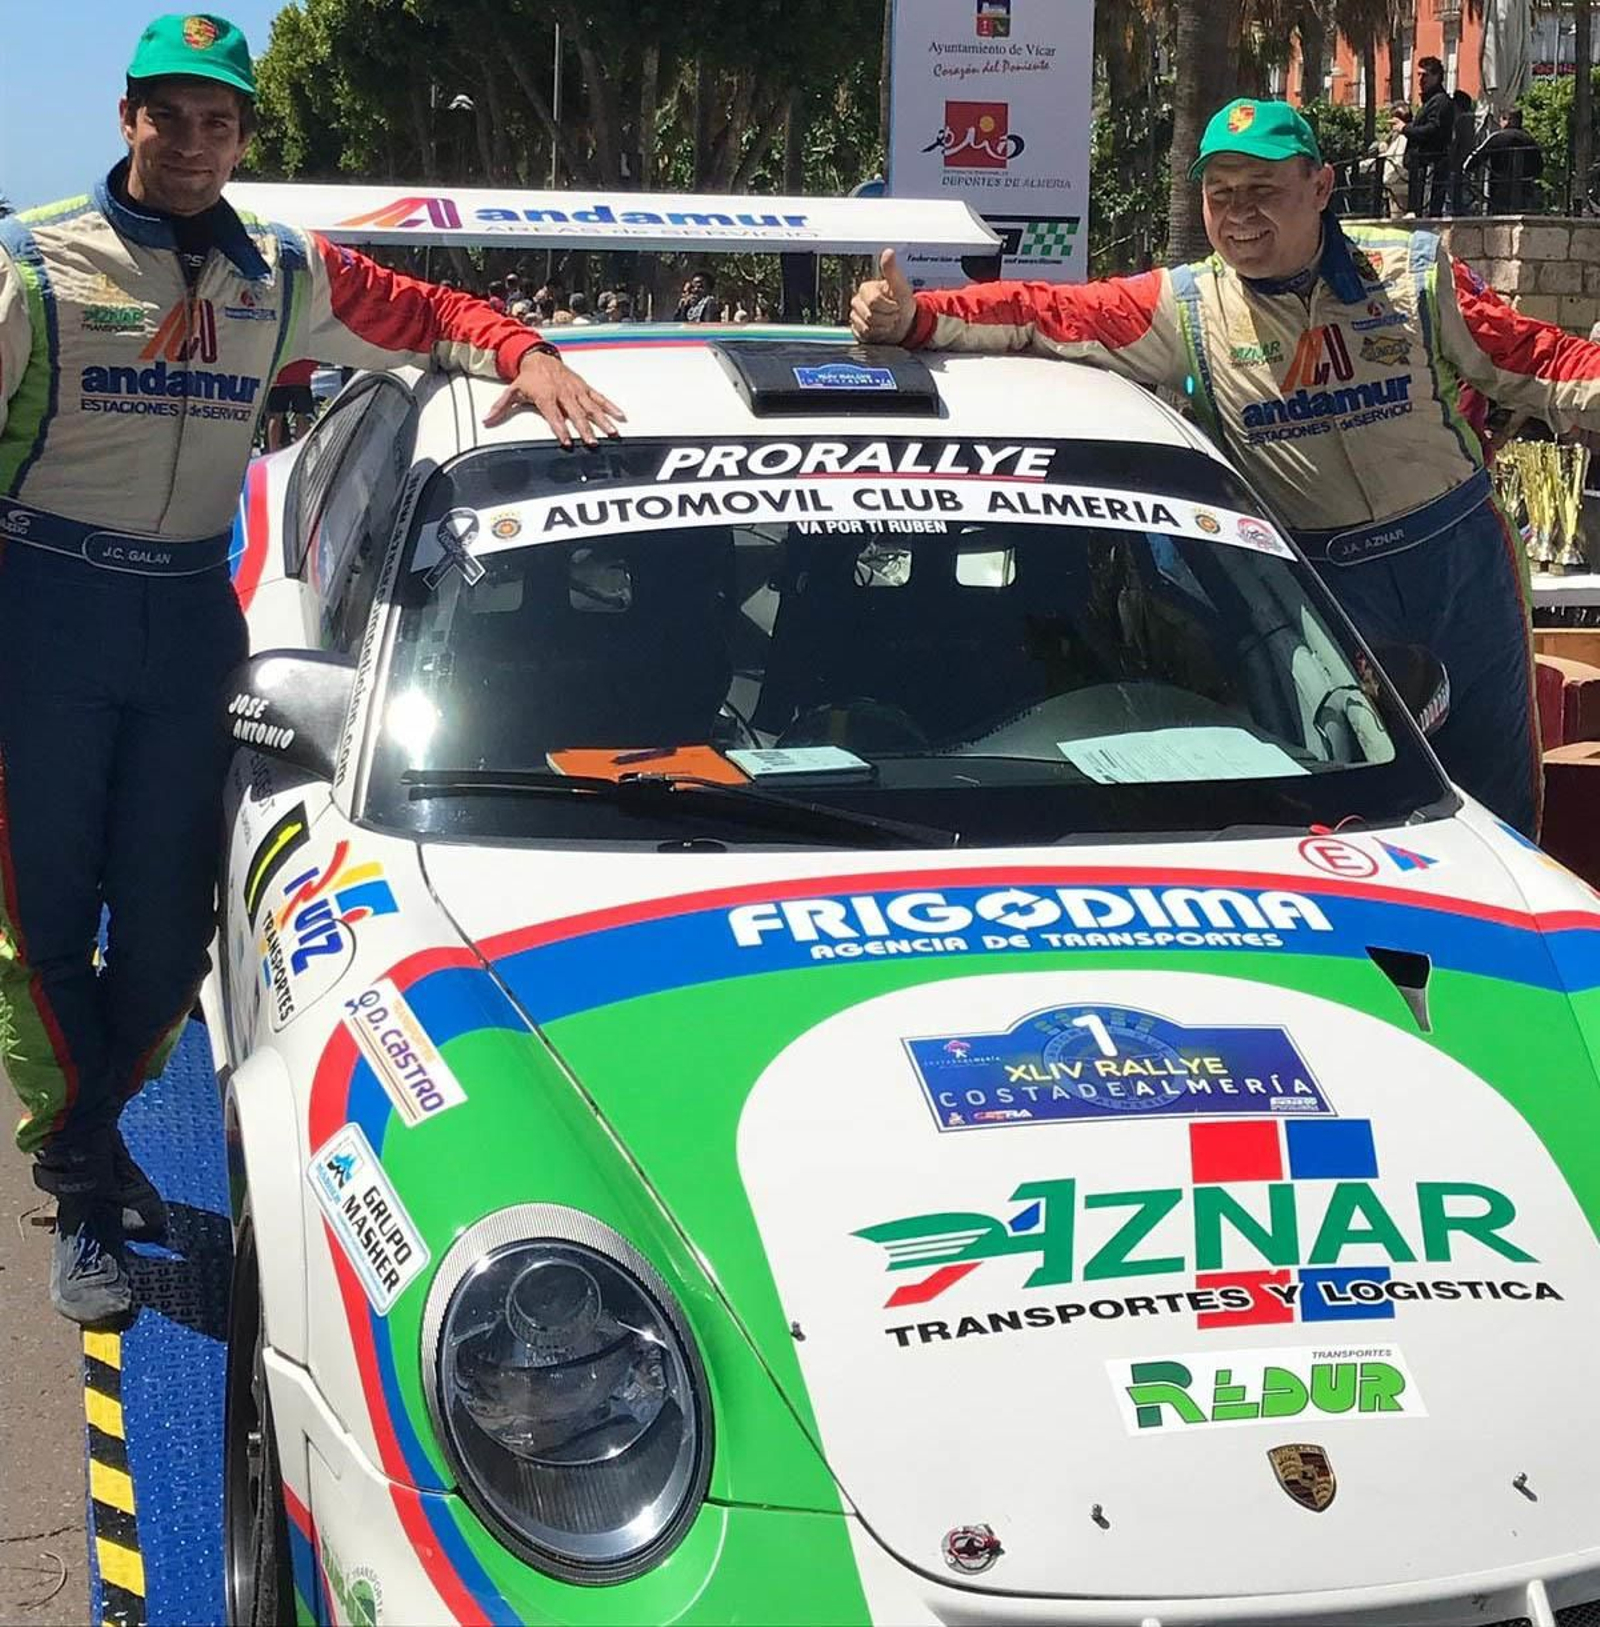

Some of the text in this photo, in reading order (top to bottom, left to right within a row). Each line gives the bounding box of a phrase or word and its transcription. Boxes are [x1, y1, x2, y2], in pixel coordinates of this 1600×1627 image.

[929, 42, 1056, 57] Ayuntamiento de Vícar
[982, 59, 1001, 73] del
[1002, 59, 1050, 73] Poniente
[942, 177, 1000, 188] DEPORTES
[1004, 178, 1021, 188] DE
[475, 205, 808, 228] andamur
[81, 361, 261, 404] andamur
[81, 398, 180, 416] ESTACIONES
[1241, 374, 1412, 429] andamur
[1248, 420, 1331, 446] ESTACIONES
[656, 442, 1056, 482] PRORALLYE
[543, 487, 1182, 532] AUTOMOVIL CLUB ALMERIA
[797, 519, 948, 535] VA POR TI RUBEN
[1364, 529, 1405, 549] AZNAR
[128, 551, 172, 564] GALAN
[228, 693, 270, 719] JOSE
[232, 718, 295, 750] ANTONIO
[247, 821, 303, 915] 1
[728, 887, 1334, 949] FRIGODIMA
[811, 931, 1285, 960] AGENCIA DE TRANSPORTES
[262, 909, 296, 1023] TRANSPORTES
[366, 1006, 389, 1031] D.
[1072, 1013, 1119, 1057] 1
[1004, 1055, 1229, 1083] XLIV RALLYE
[362, 1185, 412, 1267] GRUPO
[990, 1178, 1541, 1288] AZNAR
[342, 1193, 401, 1294] MASHER
[885, 1278, 1565, 1349] TRANSPORTES Y LOGISTICA
[1312, 1349, 1392, 1359] TRANSPORTES
[1125, 1360, 1407, 1429] REDUR
